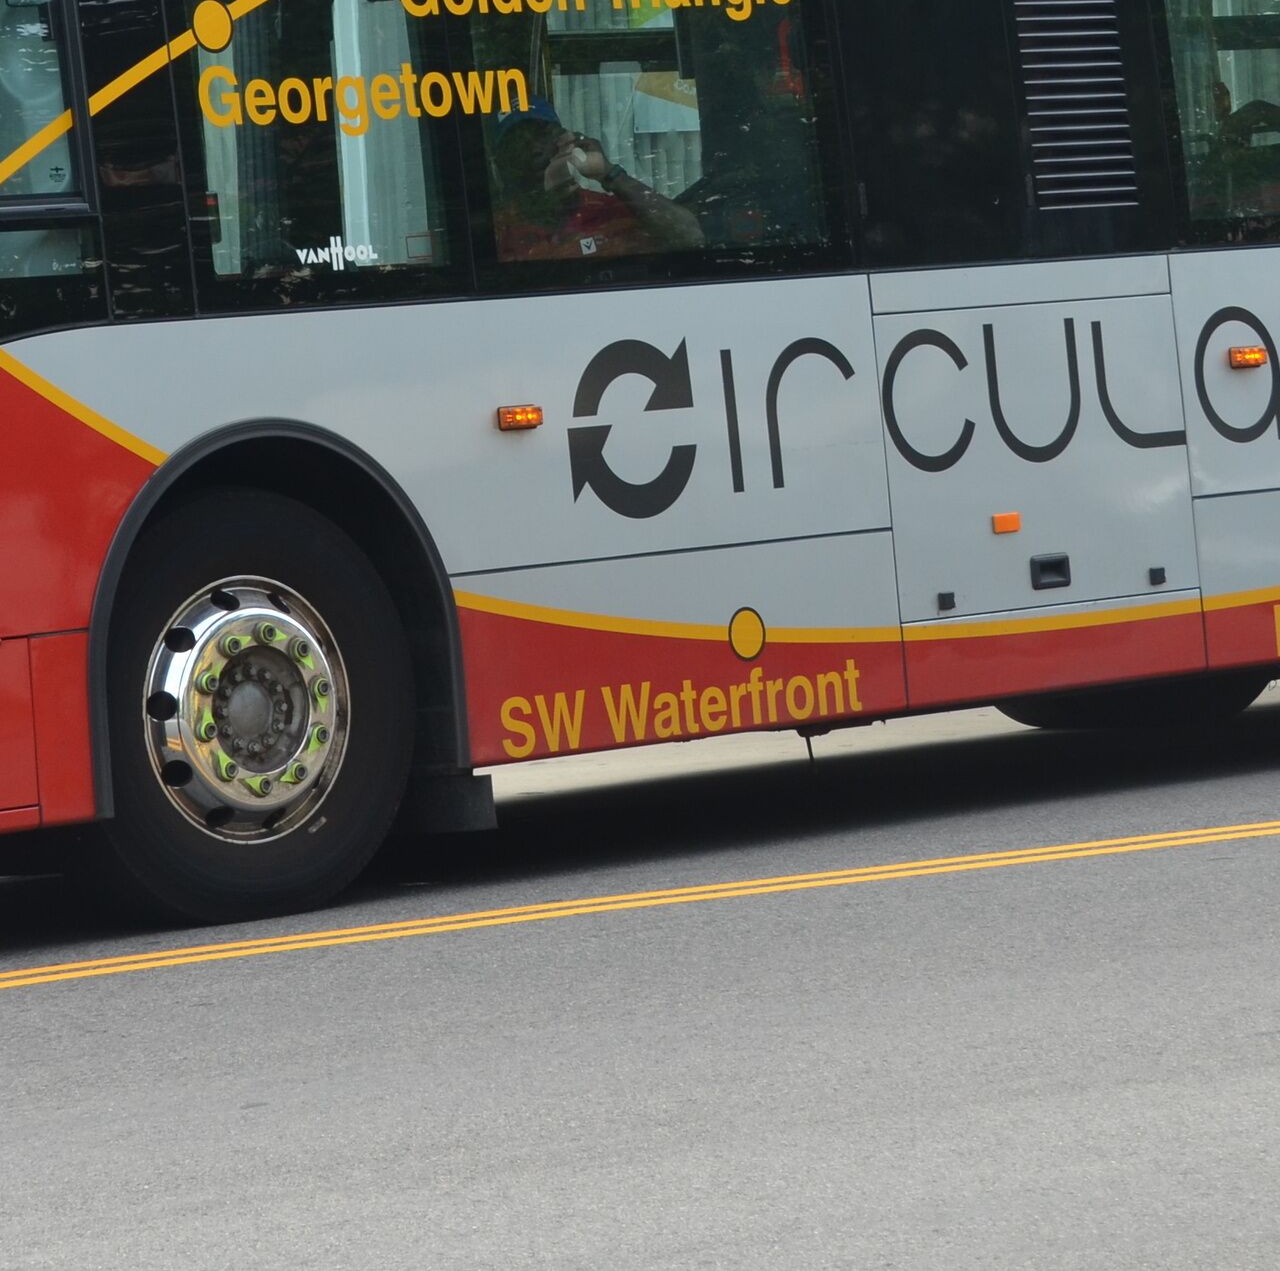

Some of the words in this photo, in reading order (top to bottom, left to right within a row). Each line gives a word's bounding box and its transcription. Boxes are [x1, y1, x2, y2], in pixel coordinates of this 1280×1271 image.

[198, 62, 529, 136] Georgetown
[499, 689, 586, 758] SW
[601, 658, 864, 743] Waterfront
